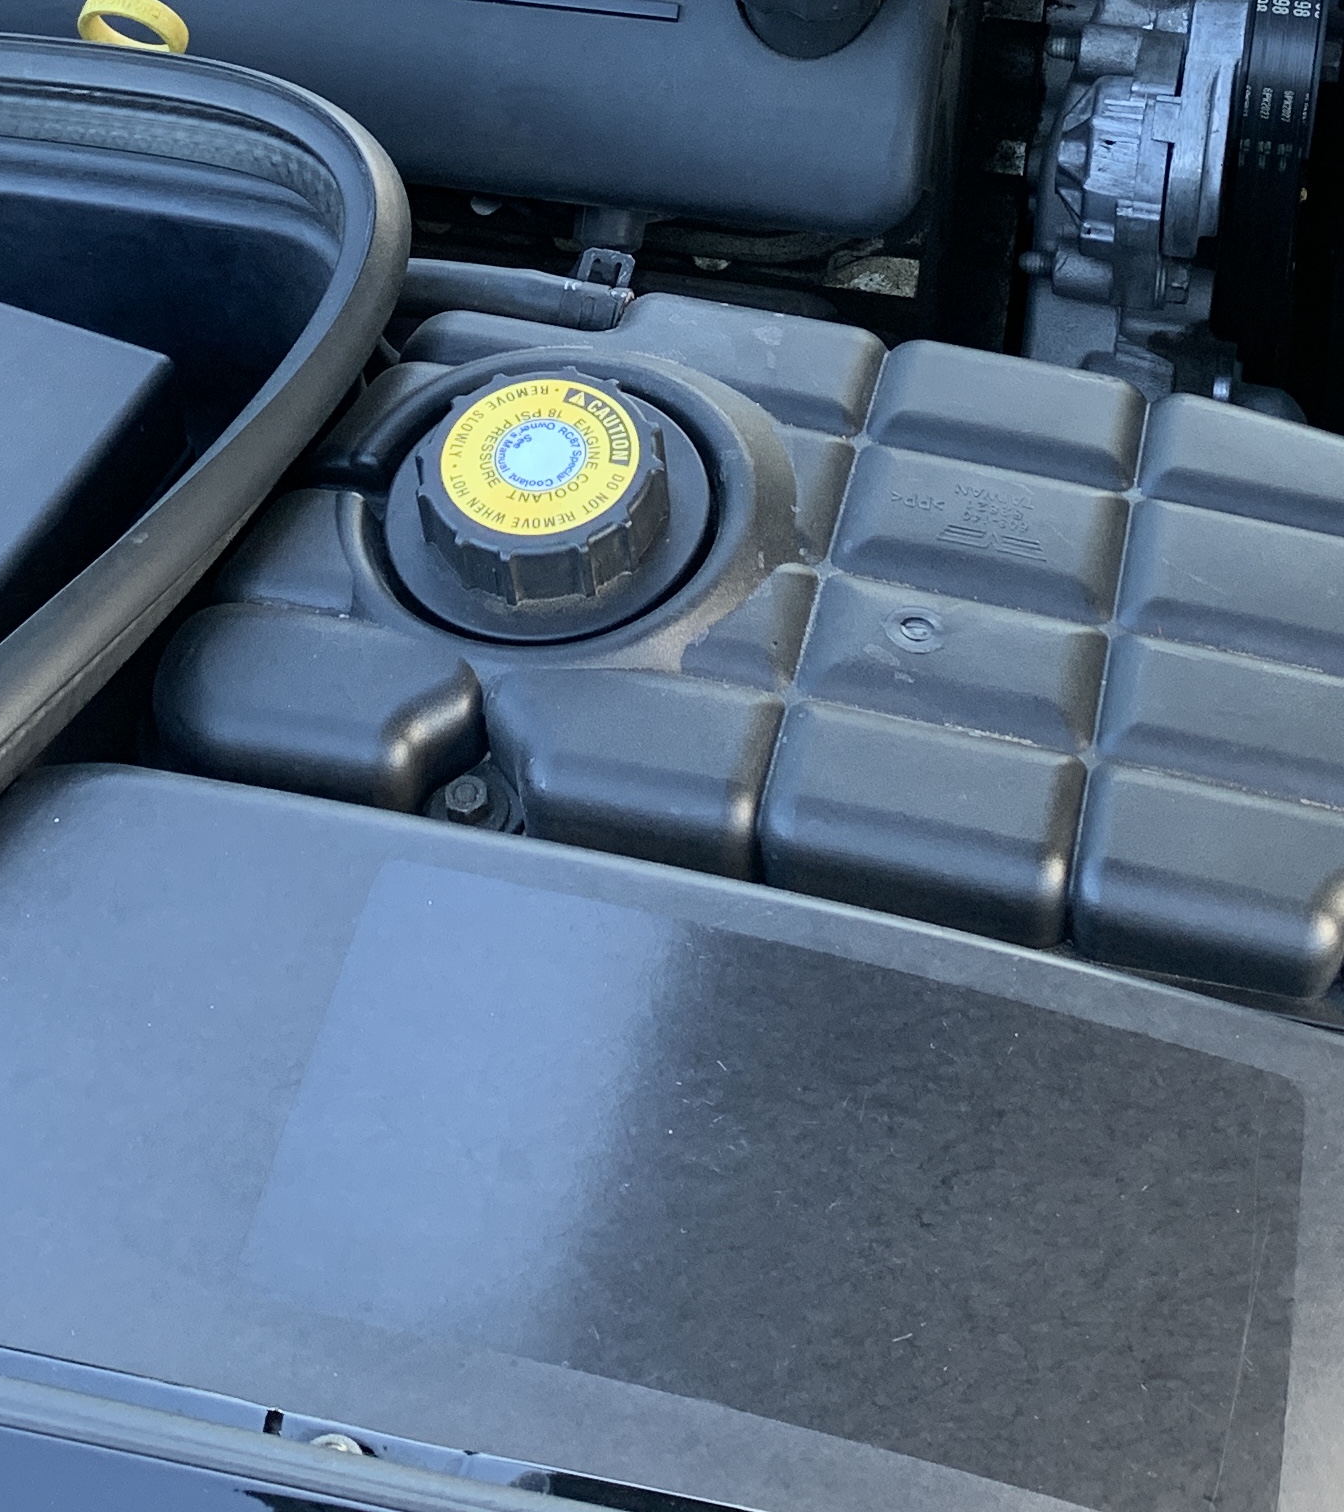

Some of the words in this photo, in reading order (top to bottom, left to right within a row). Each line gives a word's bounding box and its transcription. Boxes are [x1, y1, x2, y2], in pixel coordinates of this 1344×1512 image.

[486, 385, 549, 410] REMOVE
[515, 408, 542, 421] PSI
[547, 408, 563, 419] 18
[448, 410, 484, 459] SLOWLY
[508, 421, 556, 440] Owner's
[513, 434, 532, 450] See
[558, 426, 580, 448] RC87
[587, 399, 630, 464] CAUTION
[479, 418, 513, 488] PRESSURE
[573, 418, 602, 470] ENGINE
[496, 439, 511, 474] Manual
[556, 449, 583, 482] Special
[450, 474, 470, 497] HOT
[507, 472, 589, 502] COOLANT
[508, 472, 554, 488] Coolant
[605, 473, 625, 491] DO
[583, 492, 609, 515] NOT
[955, 484, 1034, 511] TAIWAN
[466, 496, 505, 525] WHEN
[511, 512, 576, 529] REMOVE
